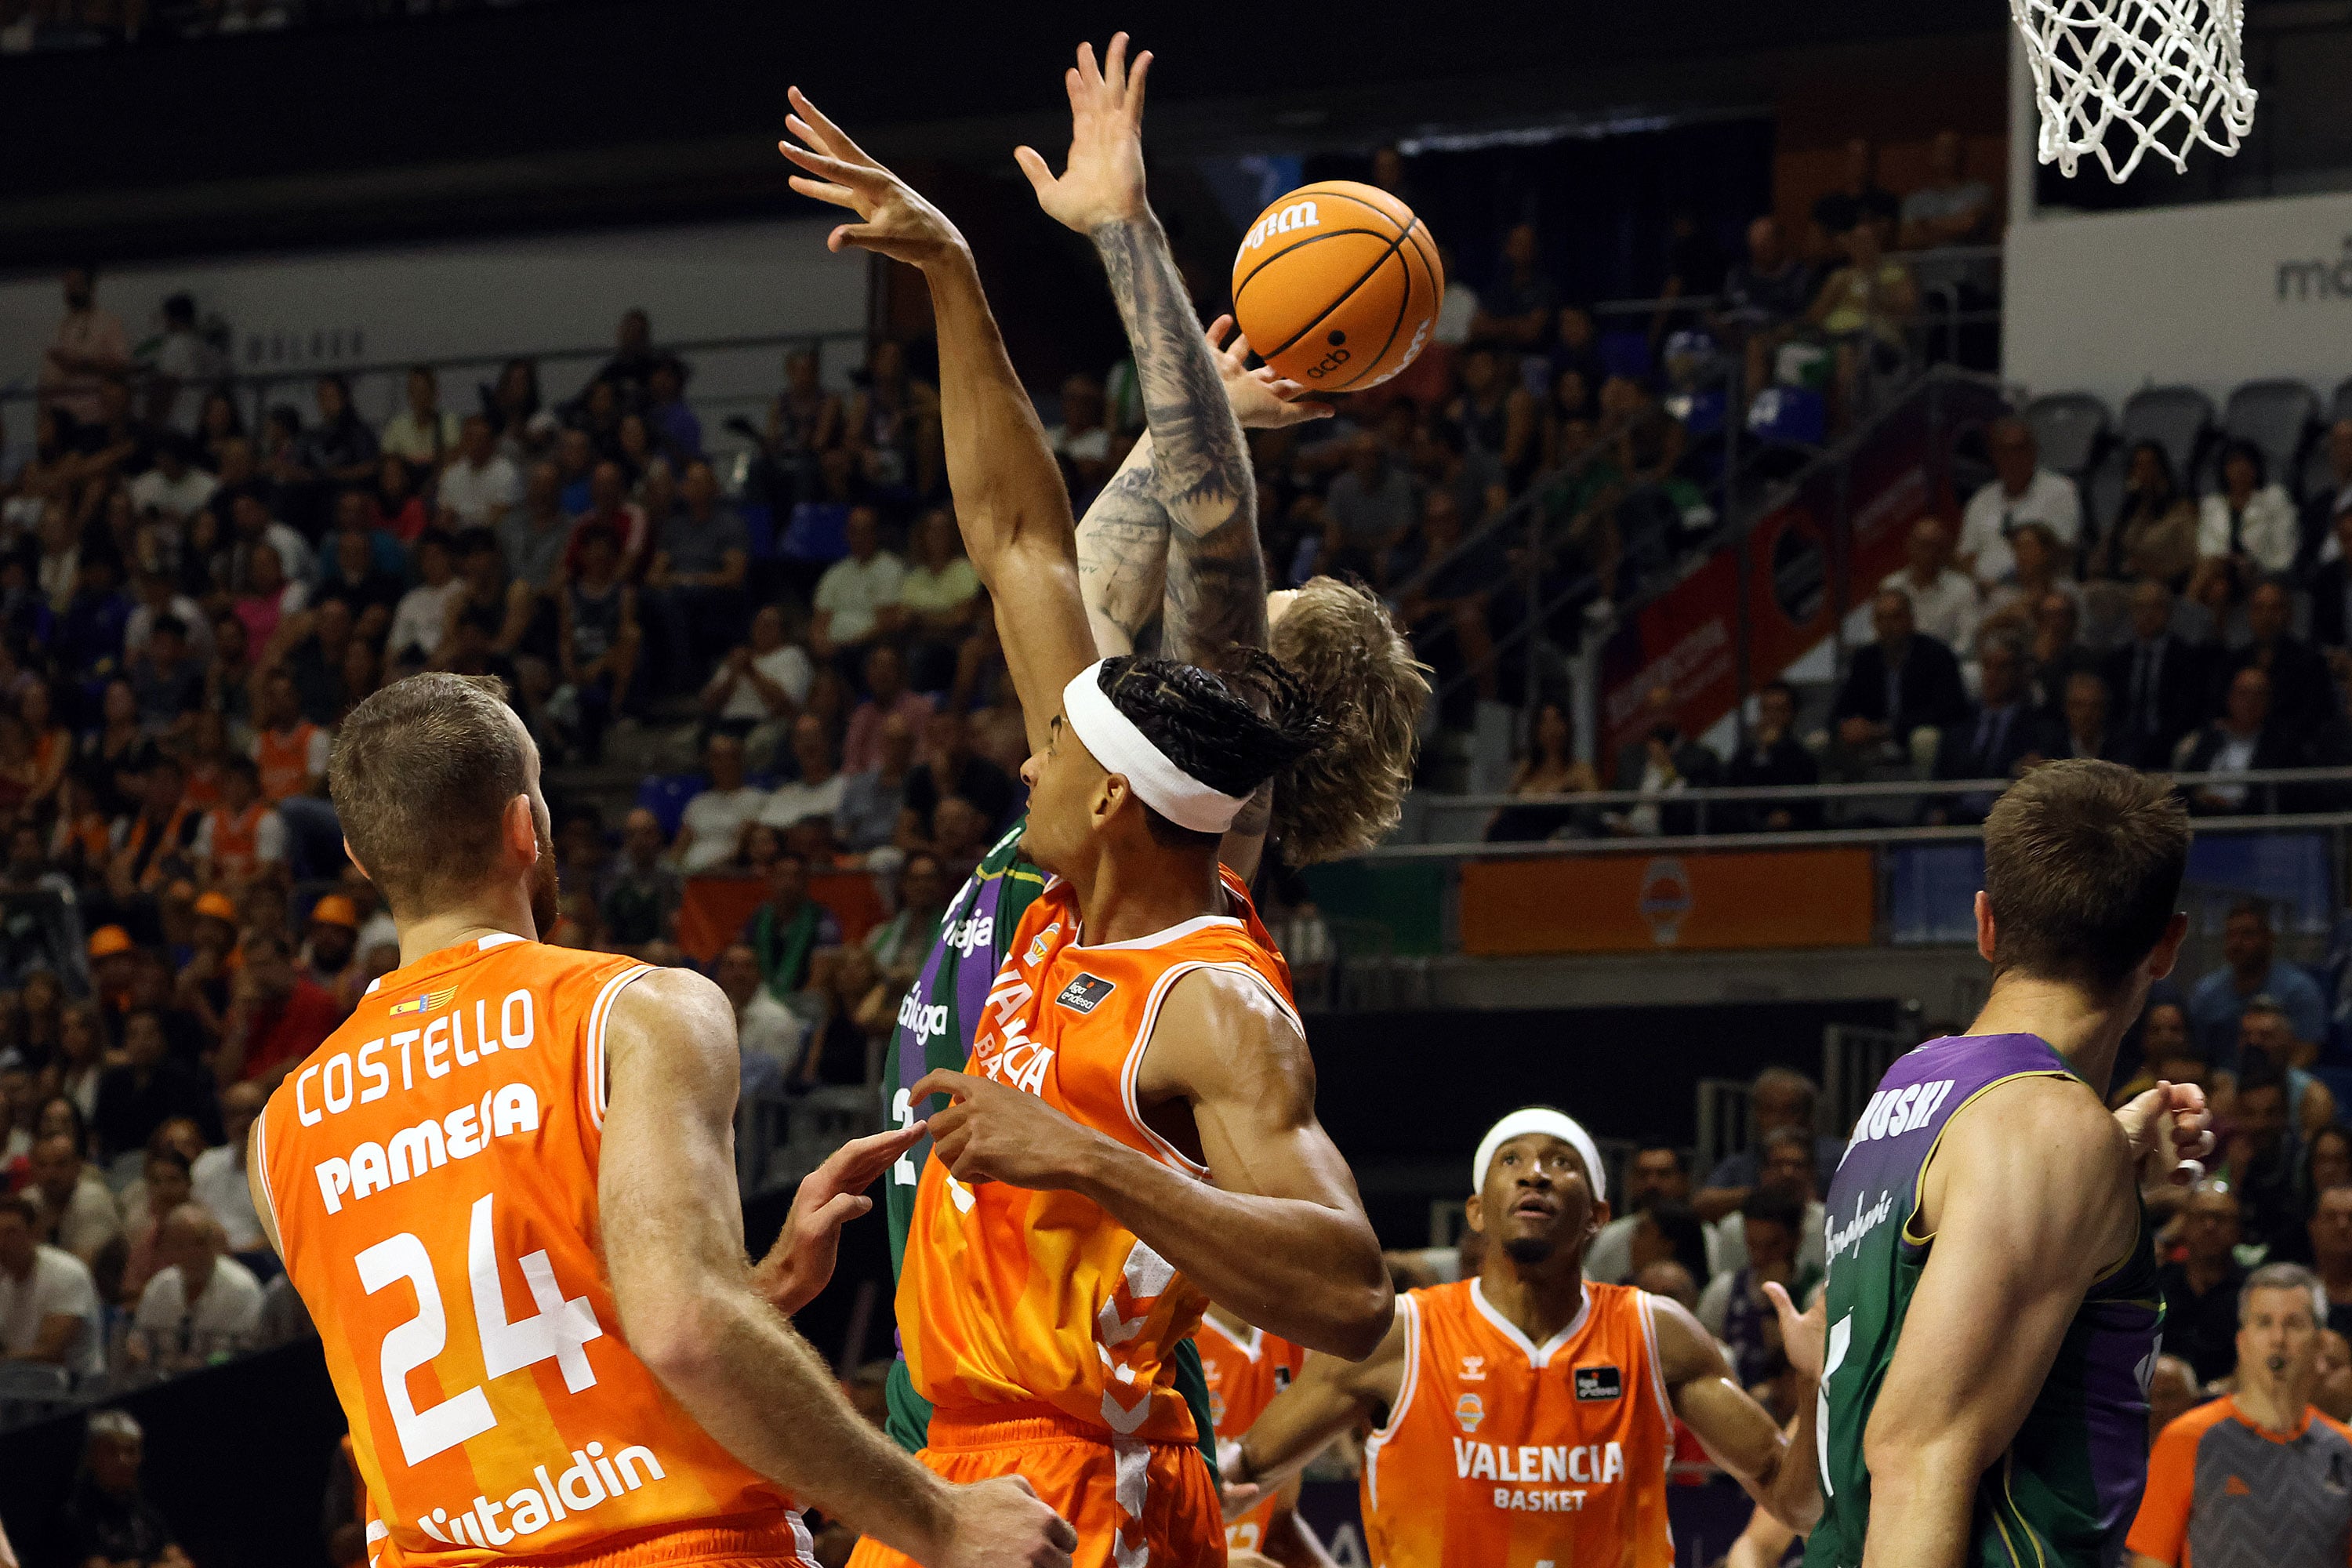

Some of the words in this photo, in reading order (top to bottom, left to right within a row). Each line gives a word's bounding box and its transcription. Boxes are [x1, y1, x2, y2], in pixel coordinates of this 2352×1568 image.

[1306, 348, 1351, 379] acb
[1061, 992, 1094, 1009] endesa
[296, 988, 535, 1128] COSTELLO
[314, 1083, 539, 1215] PAMESA
[354, 1192, 603, 1468] 24
[1453, 1436, 1624, 1483] VALENCIA
[1494, 1487, 1588, 1512] BASKET
